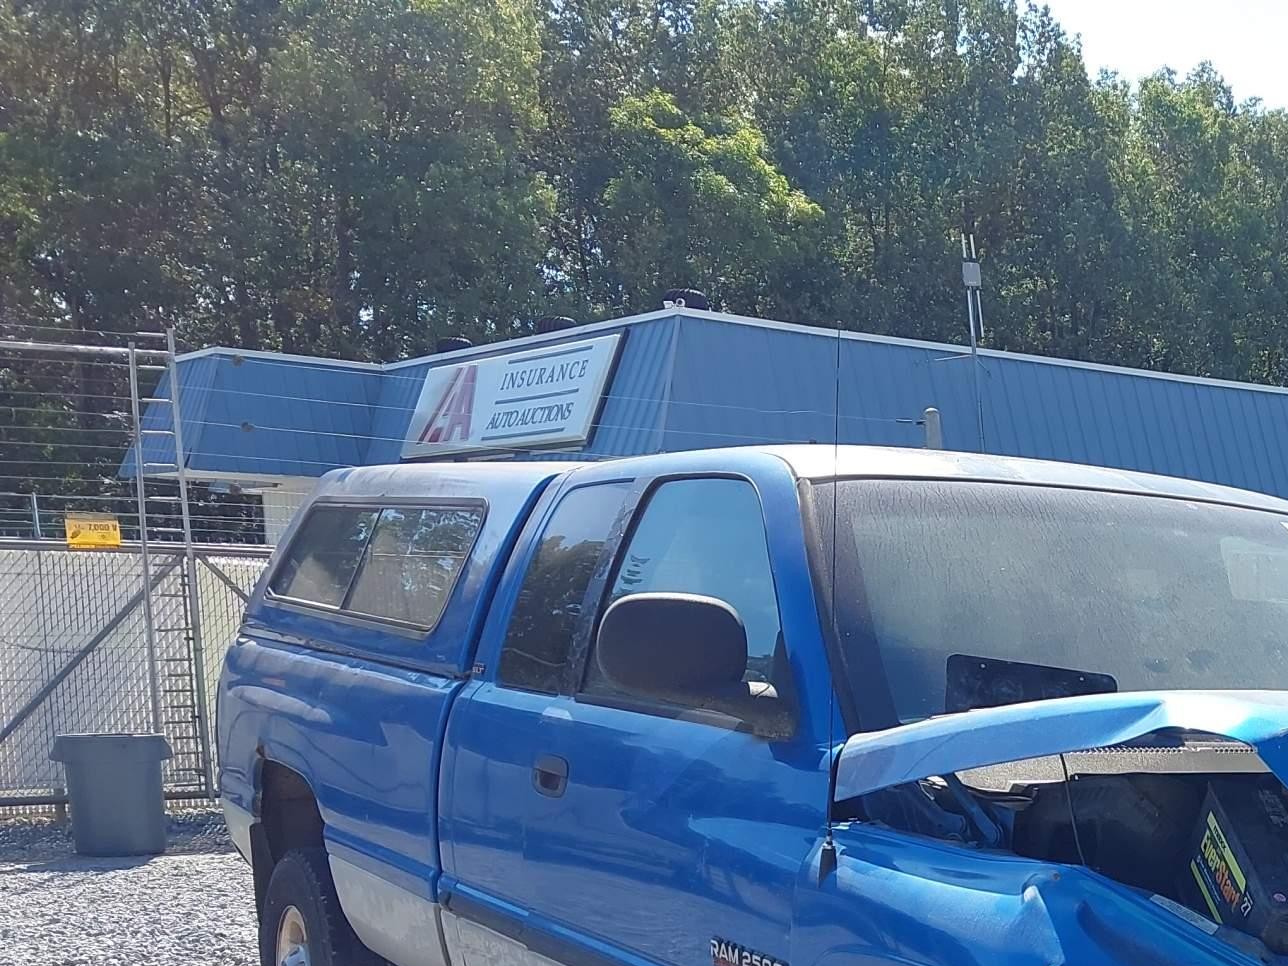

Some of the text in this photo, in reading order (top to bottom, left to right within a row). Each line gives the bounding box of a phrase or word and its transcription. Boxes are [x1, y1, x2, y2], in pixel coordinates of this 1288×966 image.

[499, 358, 590, 392] INSURANCE
[485, 401, 575, 431] AUTO AUCTIONS
[1200, 829, 1240, 913] EverStart
[1240, 896, 1252, 917] 27
[710, 939, 739, 965] RAM
